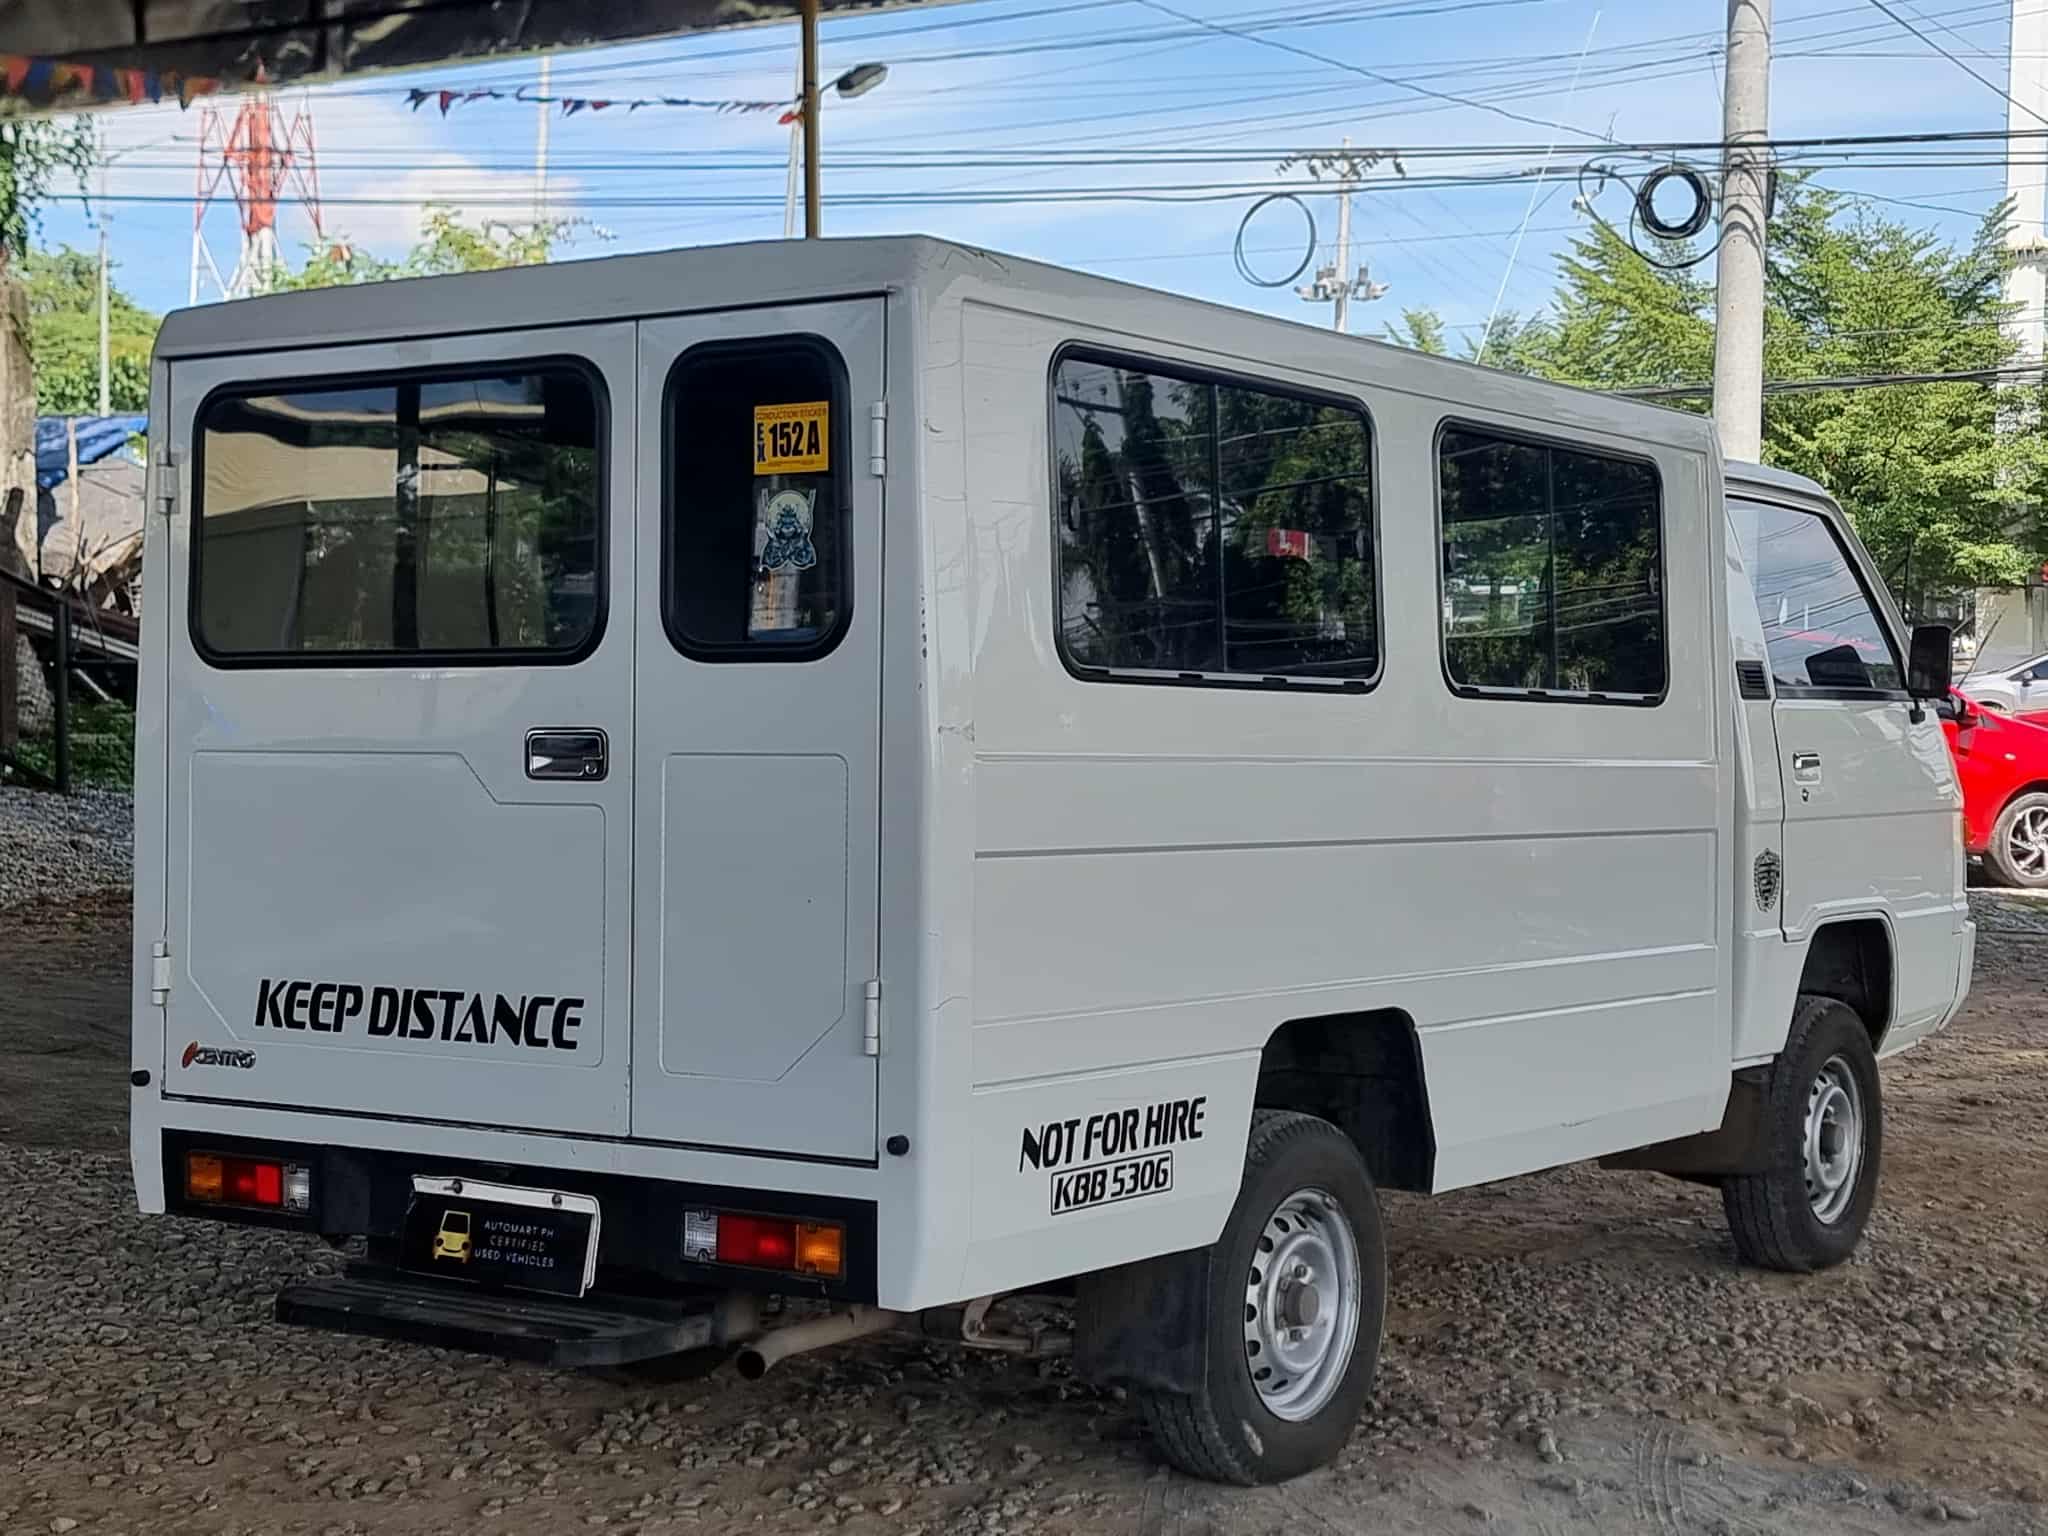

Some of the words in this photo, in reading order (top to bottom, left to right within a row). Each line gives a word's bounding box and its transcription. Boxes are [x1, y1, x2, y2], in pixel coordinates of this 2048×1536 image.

[769, 420, 820, 458] 152A
[255, 979, 363, 1032] KEEP
[367, 988, 585, 1050] DISTANCE
[1019, 1118, 1081, 1173] NOT
[1083, 1108, 1139, 1161] FOR
[1144, 1096, 1207, 1148] HIRE
[1054, 1169, 1108, 1210] KBB
[1110, 1157, 1170, 1198] 5306
[484, 1220, 538, 1235] AUTOMART
[541, 1227, 554, 1238] PH
[490, 1234, 545, 1253] CERTIFIED
[474, 1248, 500, 1260] USED
[506, 1252, 554, 1268] VEHICLES
